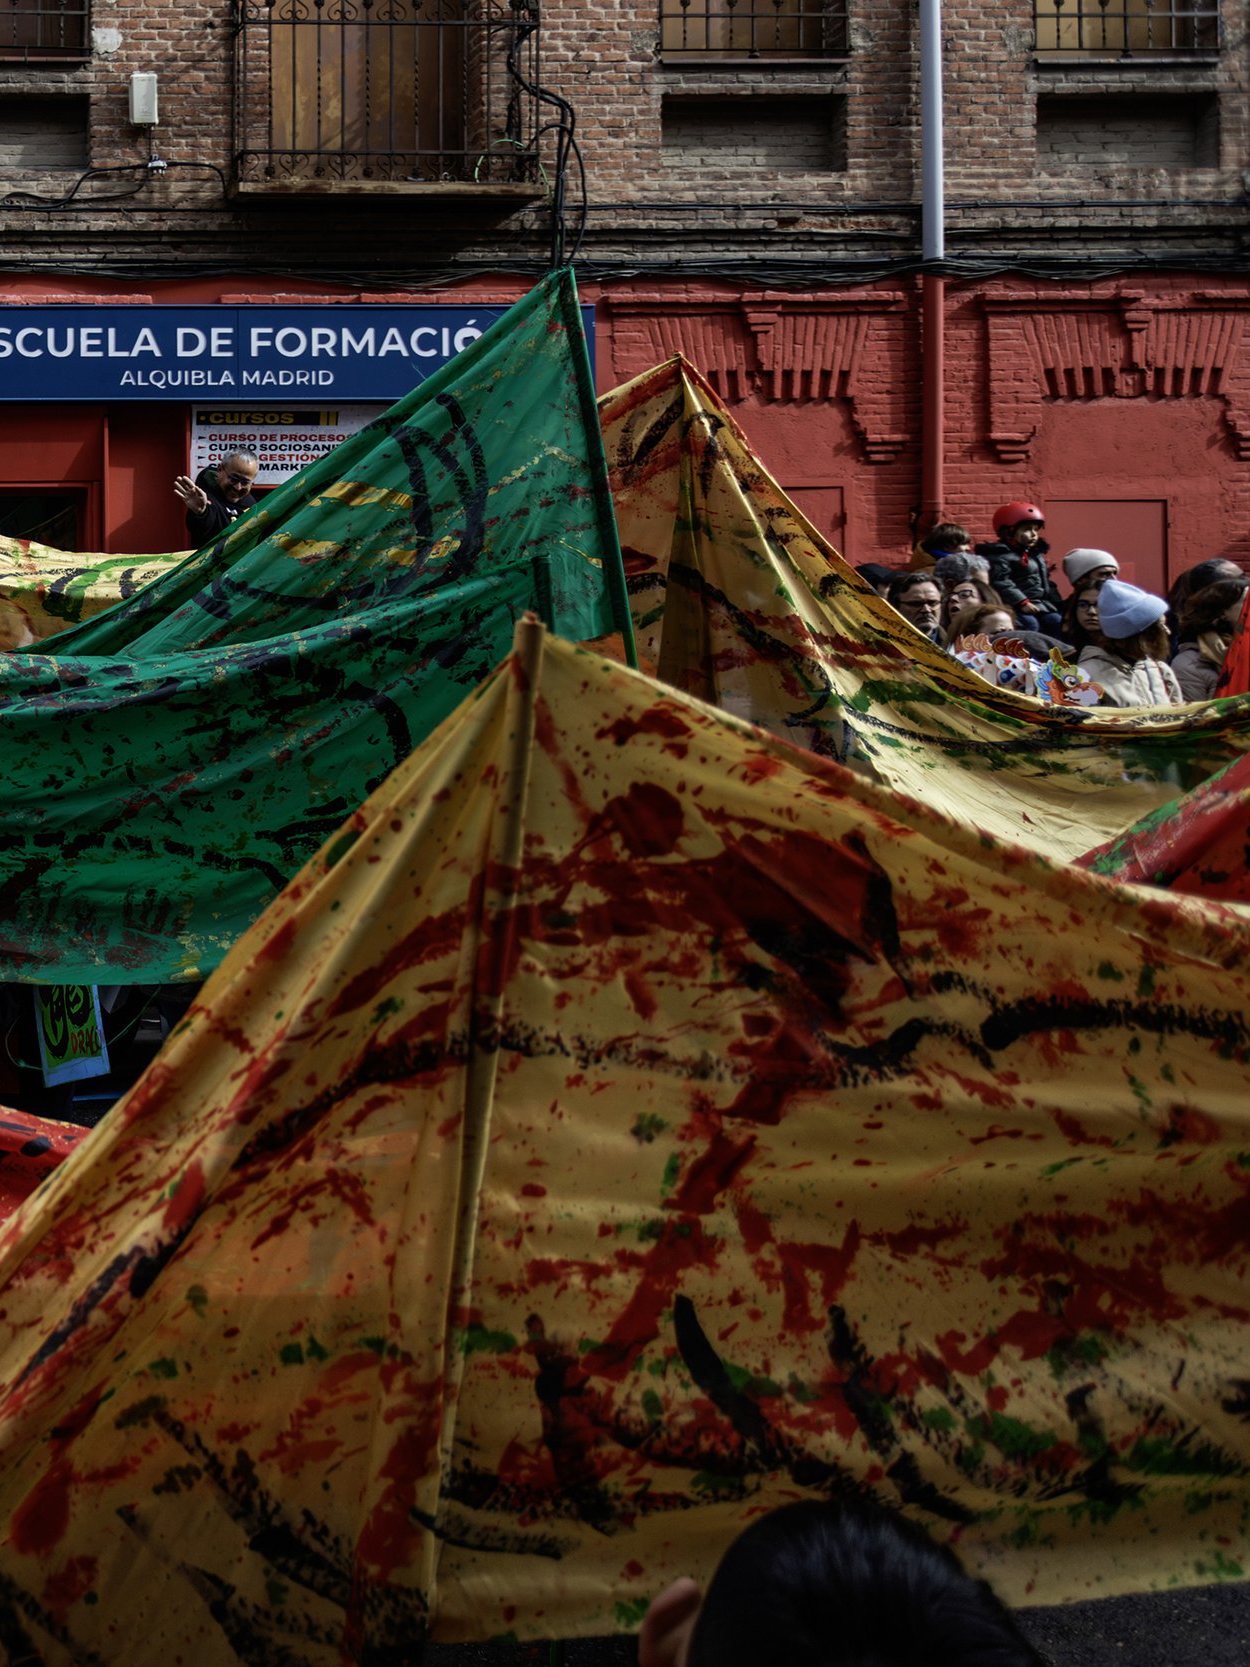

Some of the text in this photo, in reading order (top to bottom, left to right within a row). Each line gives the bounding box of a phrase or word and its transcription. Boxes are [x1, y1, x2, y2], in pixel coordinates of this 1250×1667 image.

[176, 327, 234, 357] DE
[250, 319, 484, 358] FORMACIÓ
[120, 370, 334, 389] ALQUIBLA MADRID
[209, 412, 295, 424] cursos
[208, 433, 257, 442] CURSO
[259, 433, 277, 442] DE
[208, 443, 339, 451] CURSO SOCIOSANI
[258, 463, 309, 471] MARKE
